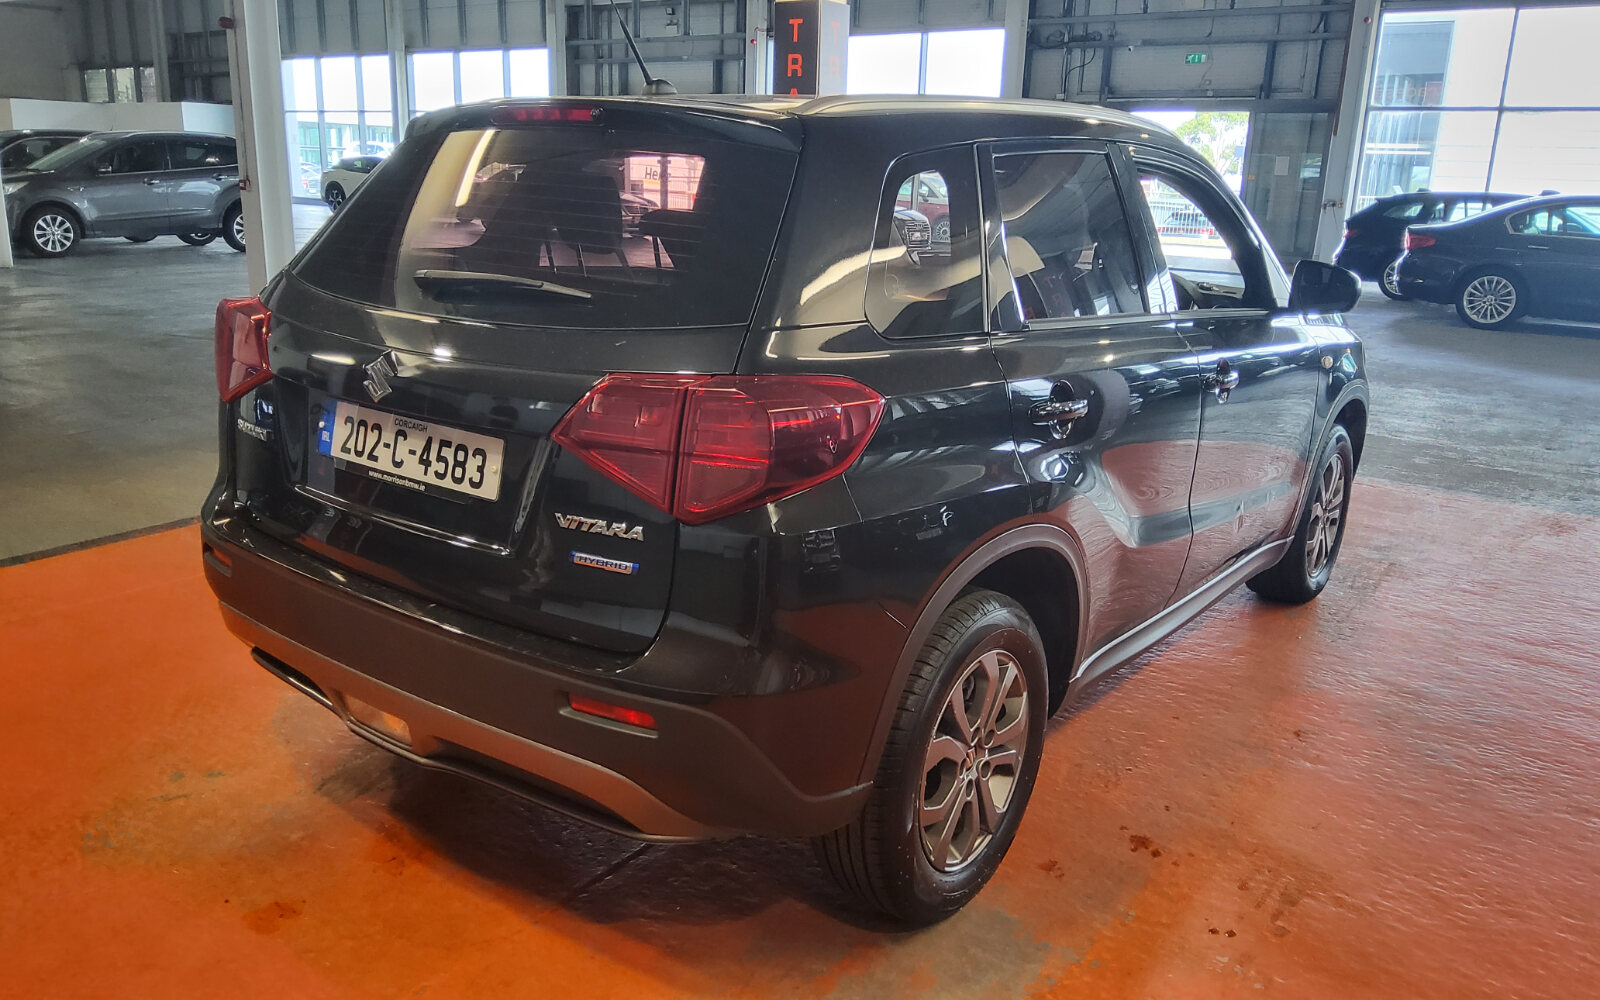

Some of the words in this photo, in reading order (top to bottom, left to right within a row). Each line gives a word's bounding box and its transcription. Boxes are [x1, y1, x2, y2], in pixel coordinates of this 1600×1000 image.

[394, 416, 428, 433] CORCAIGH
[340, 415, 487, 490] 202-C-4583
[368, 470, 426, 491] www.morrisonbmw.ie
[554, 512, 644, 541] VITARA
[577, 555, 629, 571] HYBRID
